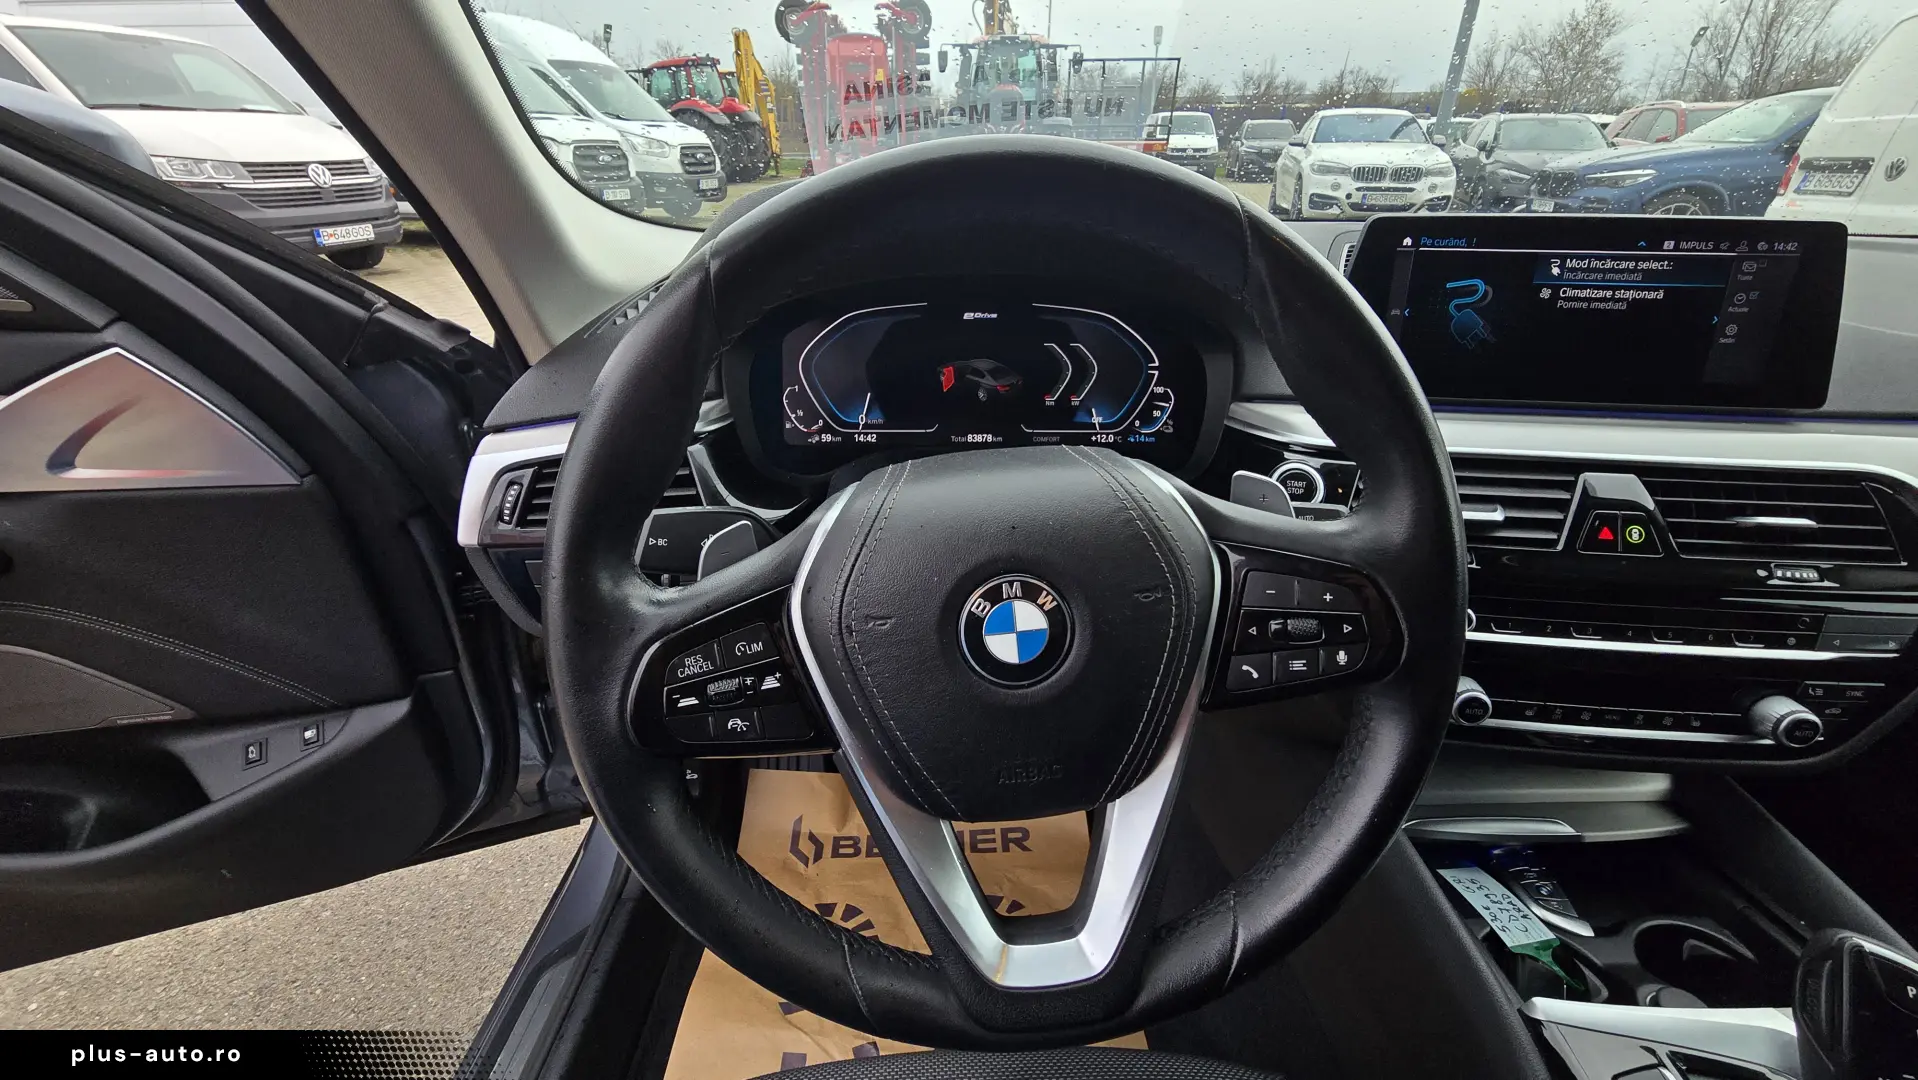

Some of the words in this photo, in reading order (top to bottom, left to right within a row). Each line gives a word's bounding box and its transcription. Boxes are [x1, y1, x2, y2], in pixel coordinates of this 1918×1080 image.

[1420, 237, 1433, 246] Pe
[1680, 241, 1715, 250] IMPULS
[1774, 242, 1799, 251] 14:42
[1566, 259, 1588, 269] Mod
[1590, 258, 1635, 270] încărcare
[1605, 271, 1643, 281] imediată
[1560, 288, 1613, 299] Climatizare
[1557, 300, 1588, 310] Pornire
[1590, 300, 1627, 310] imediată
[821, 434, 832, 443] 59
[854, 434, 877, 443] 14:42
[967, 434, 993, 443] 83878
[1286, 480, 1307, 488] START
[657, 538, 668, 546] BC
[971, 582, 1058, 619] BMW
[745, 641, 764, 655] LIM
[684, 655, 704, 668] RES
[677, 661, 715, 679] CANCEL
[1846, 689, 1865, 697] SYNC
[1465, 708, 1485, 716] AUTO
[1793, 729, 1814, 738] AUTO
